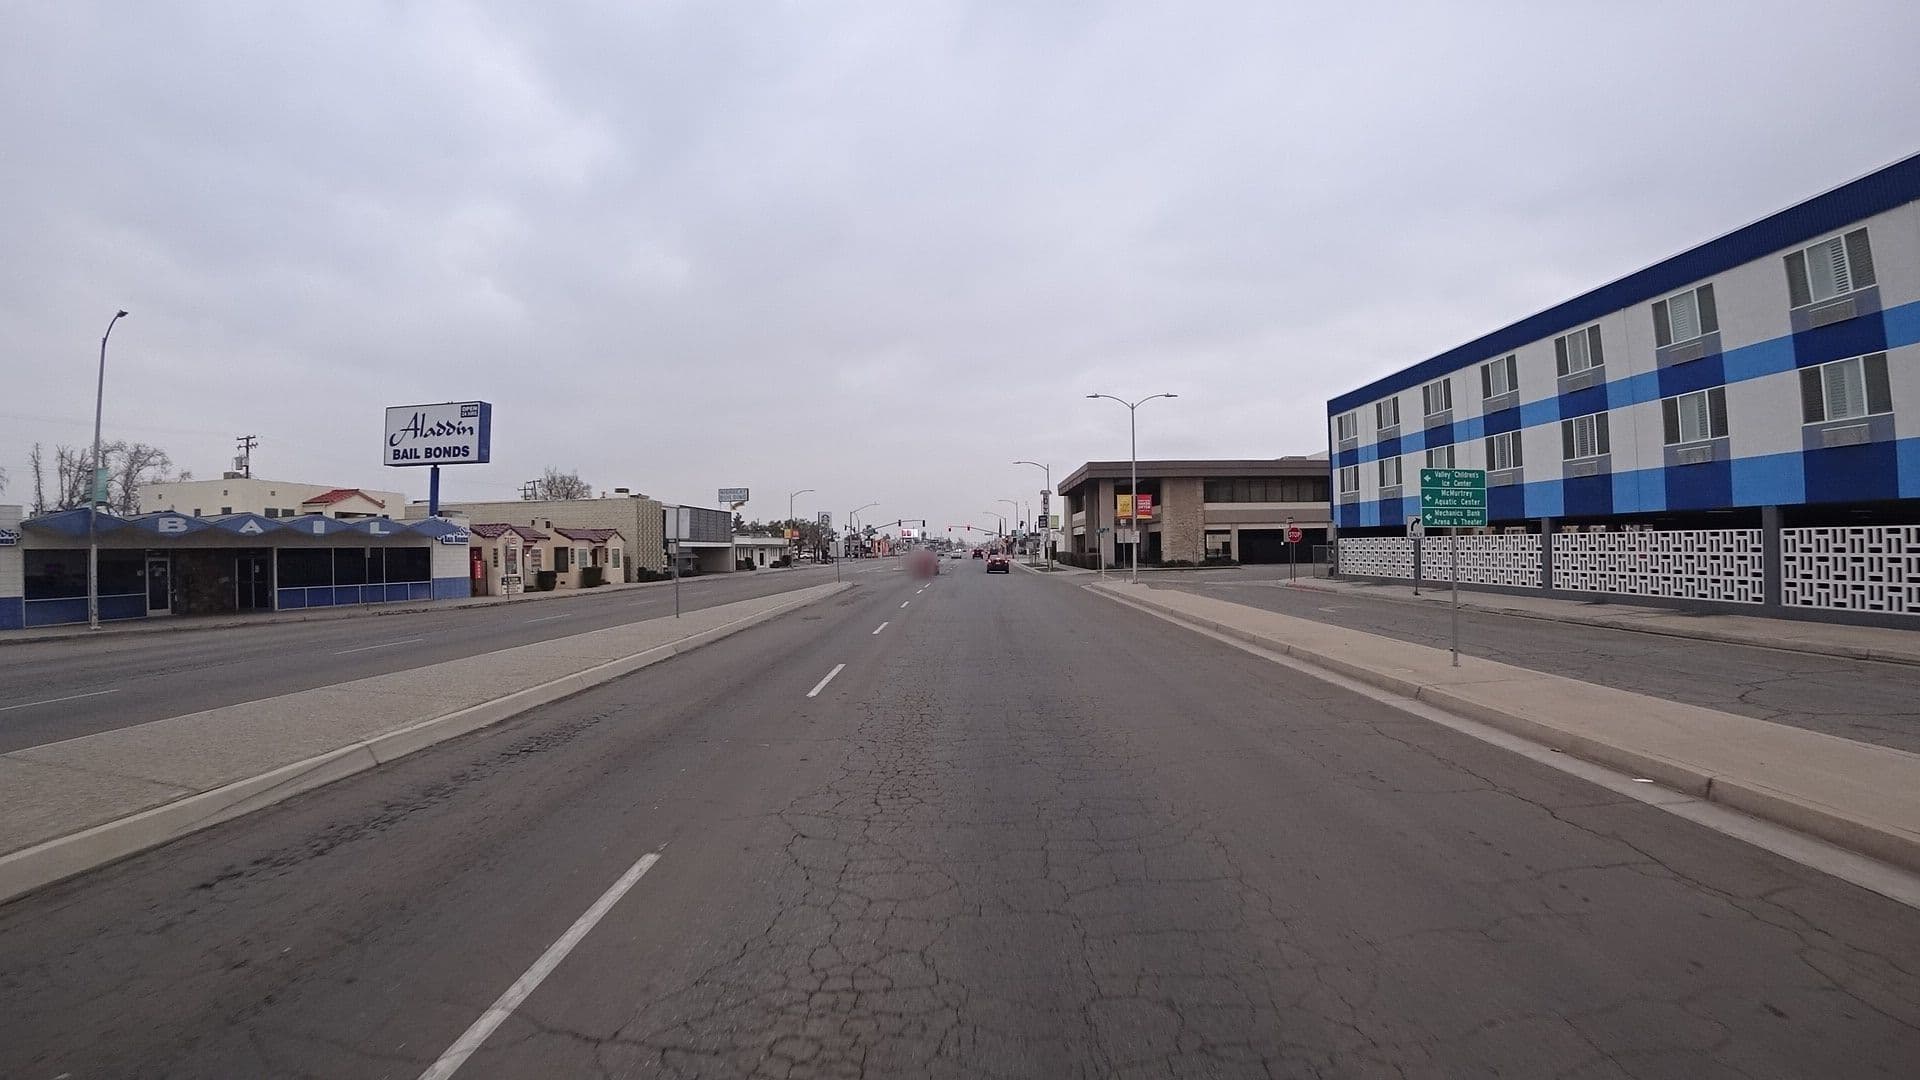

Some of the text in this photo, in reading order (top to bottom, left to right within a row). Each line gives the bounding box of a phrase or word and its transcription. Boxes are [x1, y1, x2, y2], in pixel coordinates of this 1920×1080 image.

[389, 412, 474, 446] Aladdin
[393, 445, 470, 460] BAIL BONDS
[1434, 471, 1479, 479] Valley Children's
[1441, 489, 1473, 498] McMurtrey
[1434, 509, 1463, 517] Mechanics
